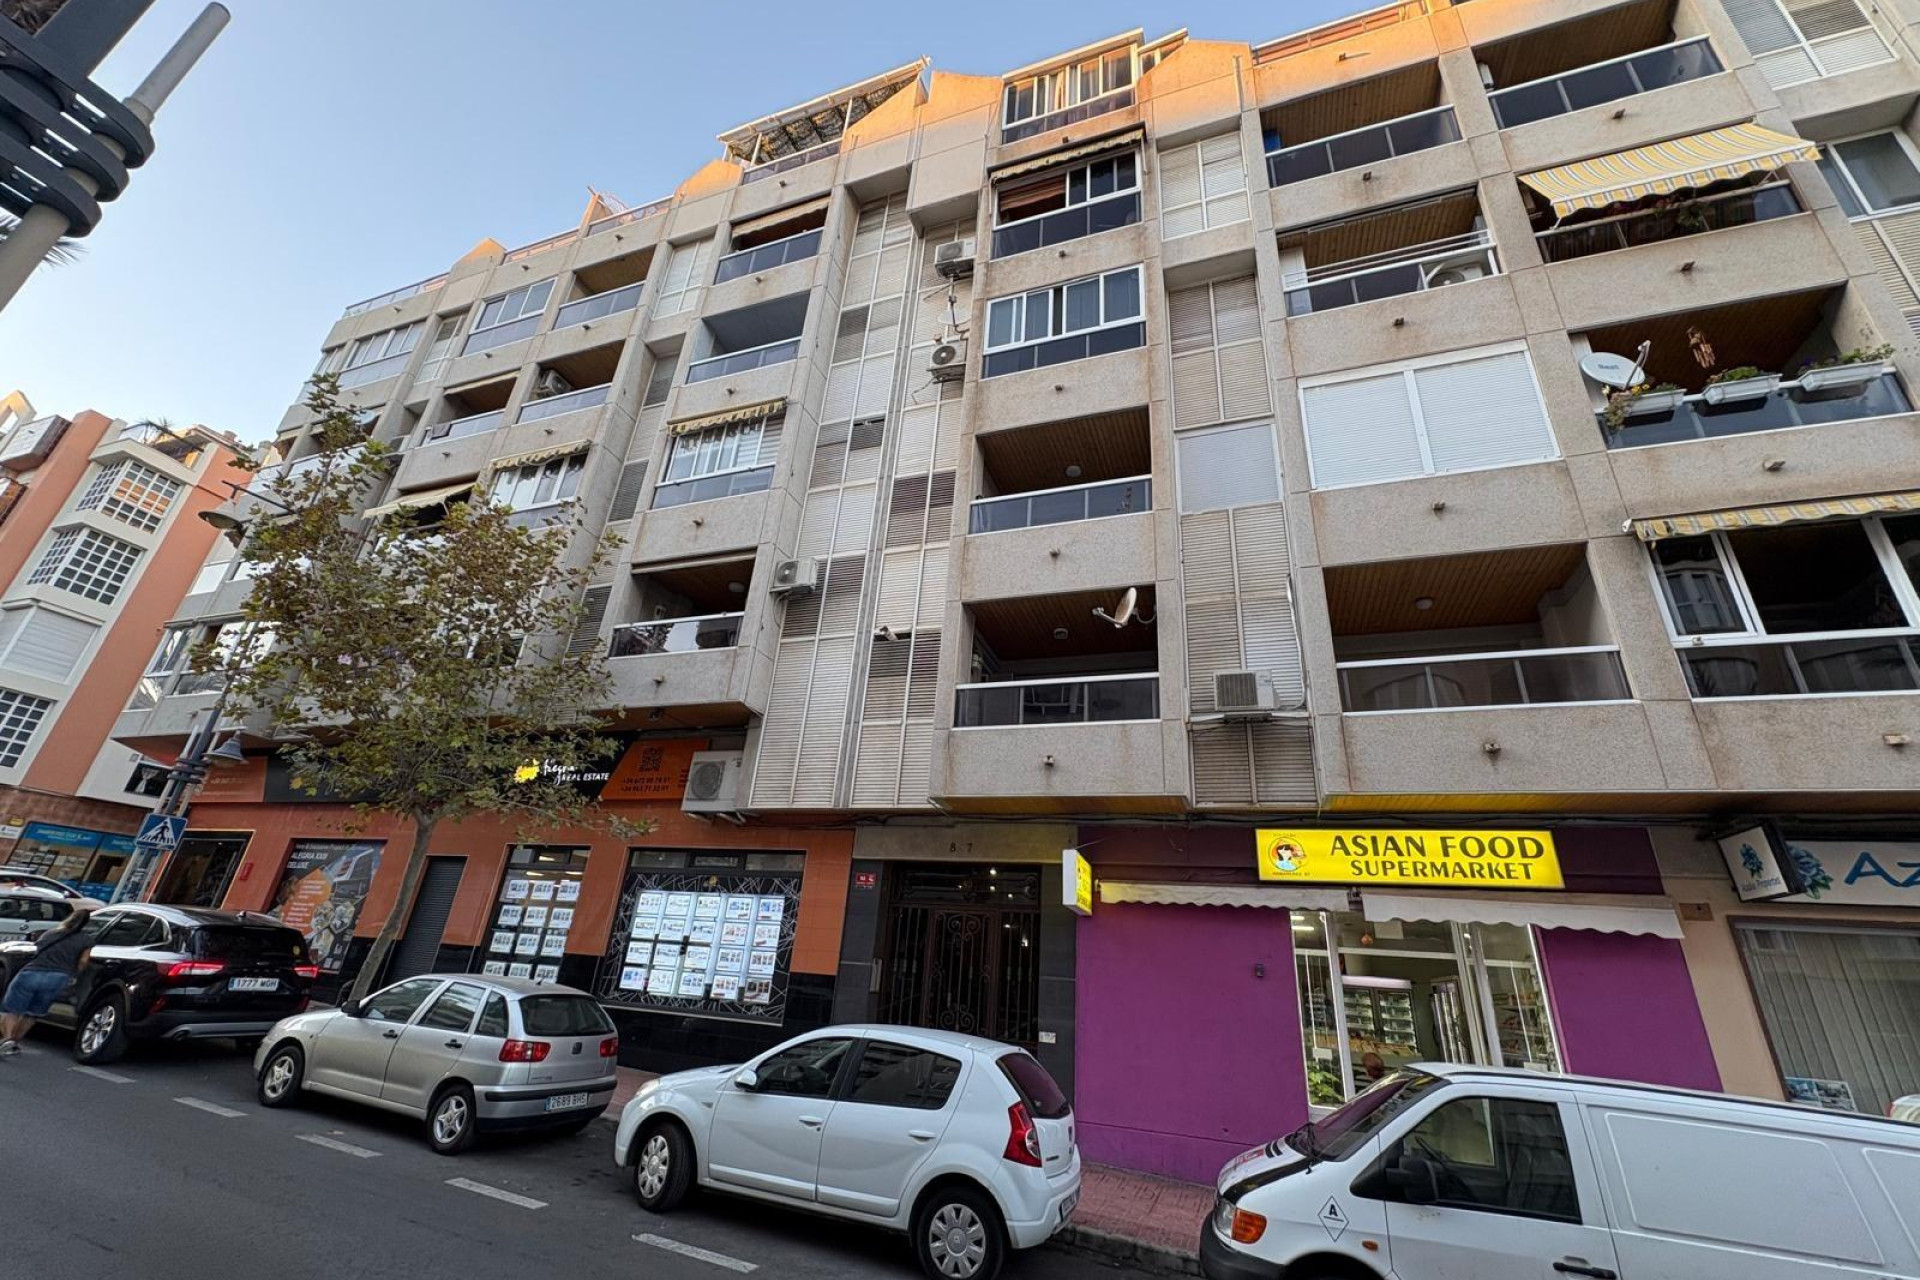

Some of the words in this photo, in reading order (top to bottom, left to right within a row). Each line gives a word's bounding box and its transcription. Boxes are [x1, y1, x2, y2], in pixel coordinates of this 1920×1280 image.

[583, 772, 611, 781] ESTATE
[1331, 835, 1426, 857] ASIAN
[1440, 836, 1544, 859] FOOD
[1351, 859, 1533, 880] SUPERMARKET
[238, 979, 259, 988] 1777
[1328, 1203, 1338, 1217] A
